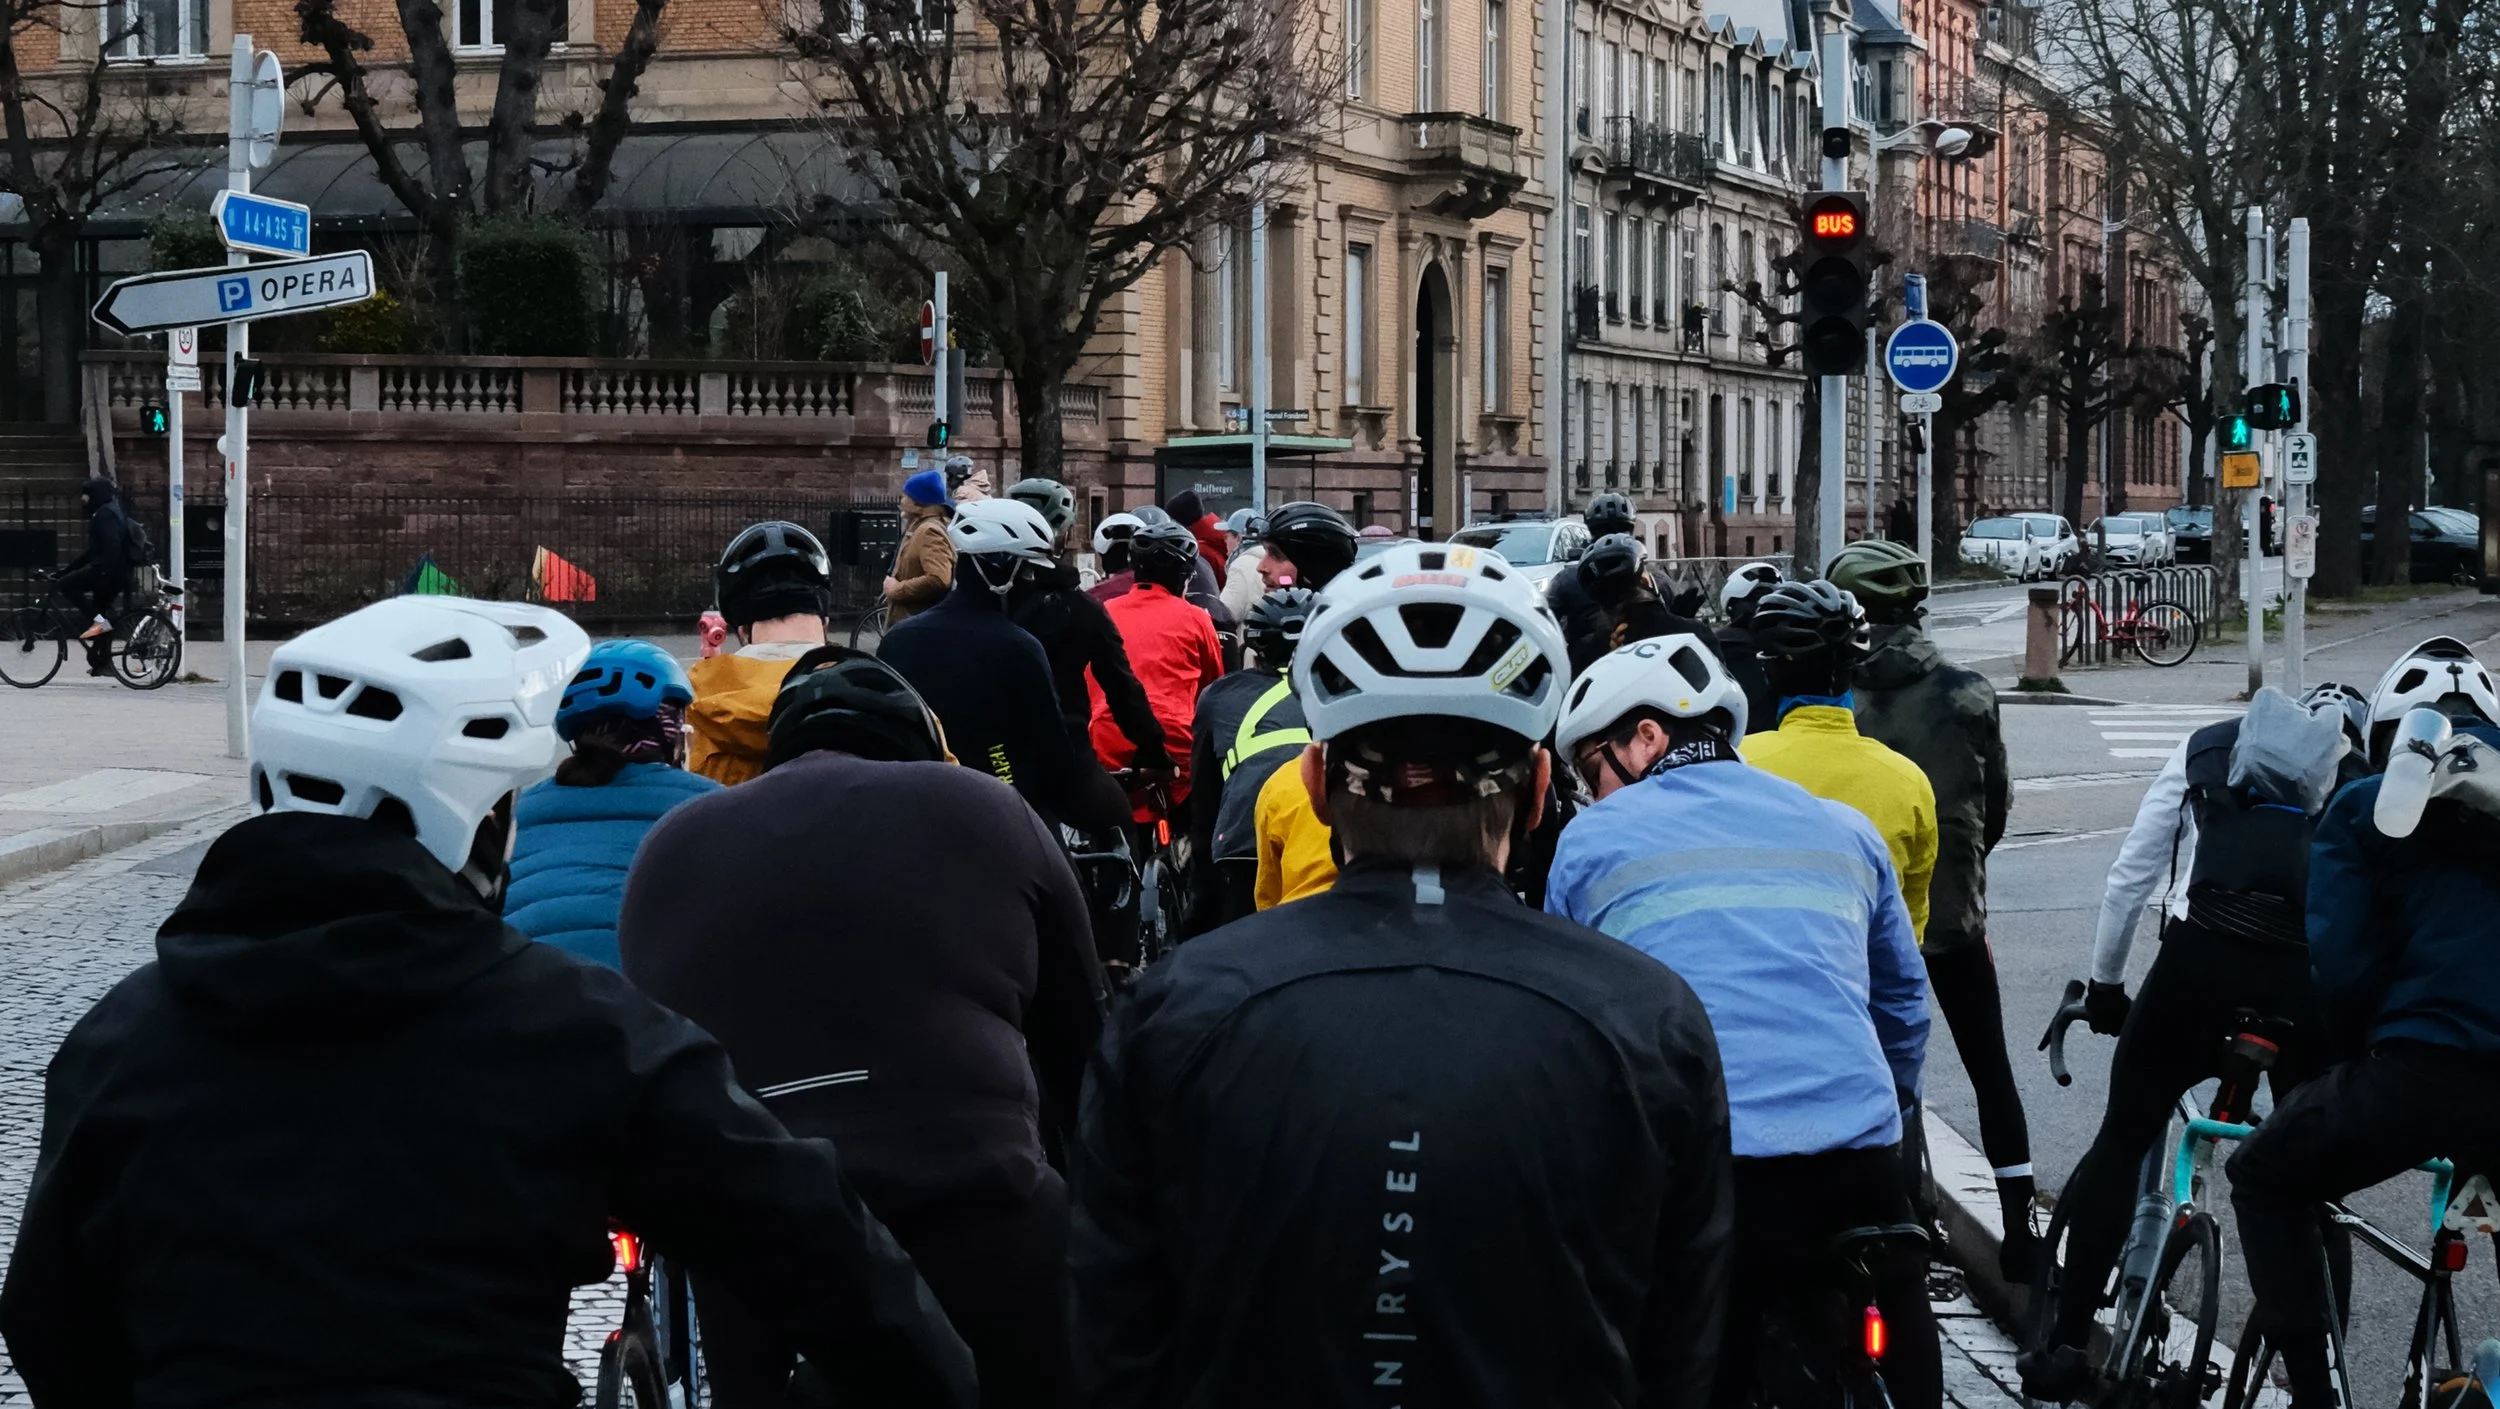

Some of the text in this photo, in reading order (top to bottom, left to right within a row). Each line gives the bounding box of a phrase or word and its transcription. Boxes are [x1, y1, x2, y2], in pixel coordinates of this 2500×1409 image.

[1817, 214, 1854, 233] BUS
[223, 266, 356, 310] P OPERA
[1376, 1131, 1421, 1314] RYSEL
